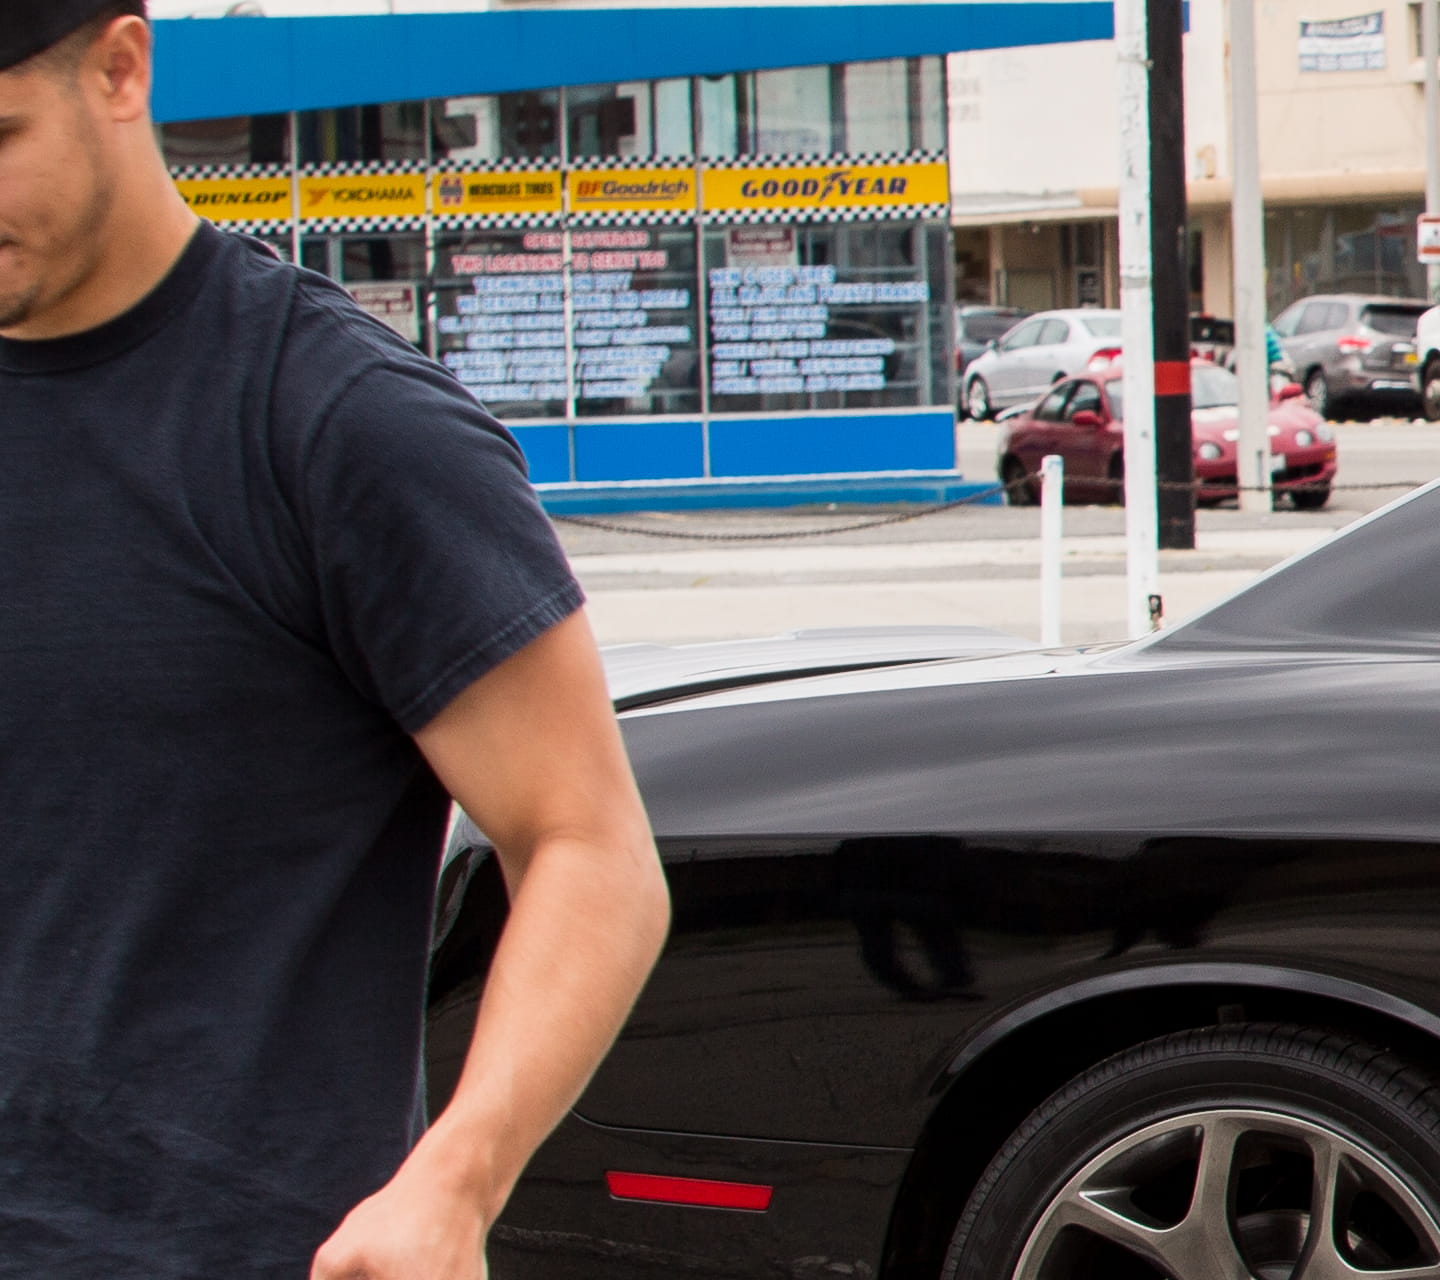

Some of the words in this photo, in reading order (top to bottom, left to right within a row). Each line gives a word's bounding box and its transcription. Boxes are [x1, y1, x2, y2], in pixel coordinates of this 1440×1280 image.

[330, 186, 414, 203] YOKOHAMA
[576, 179, 689, 199] BFGoodrich
[192, 190, 288, 207] DUNLOP
